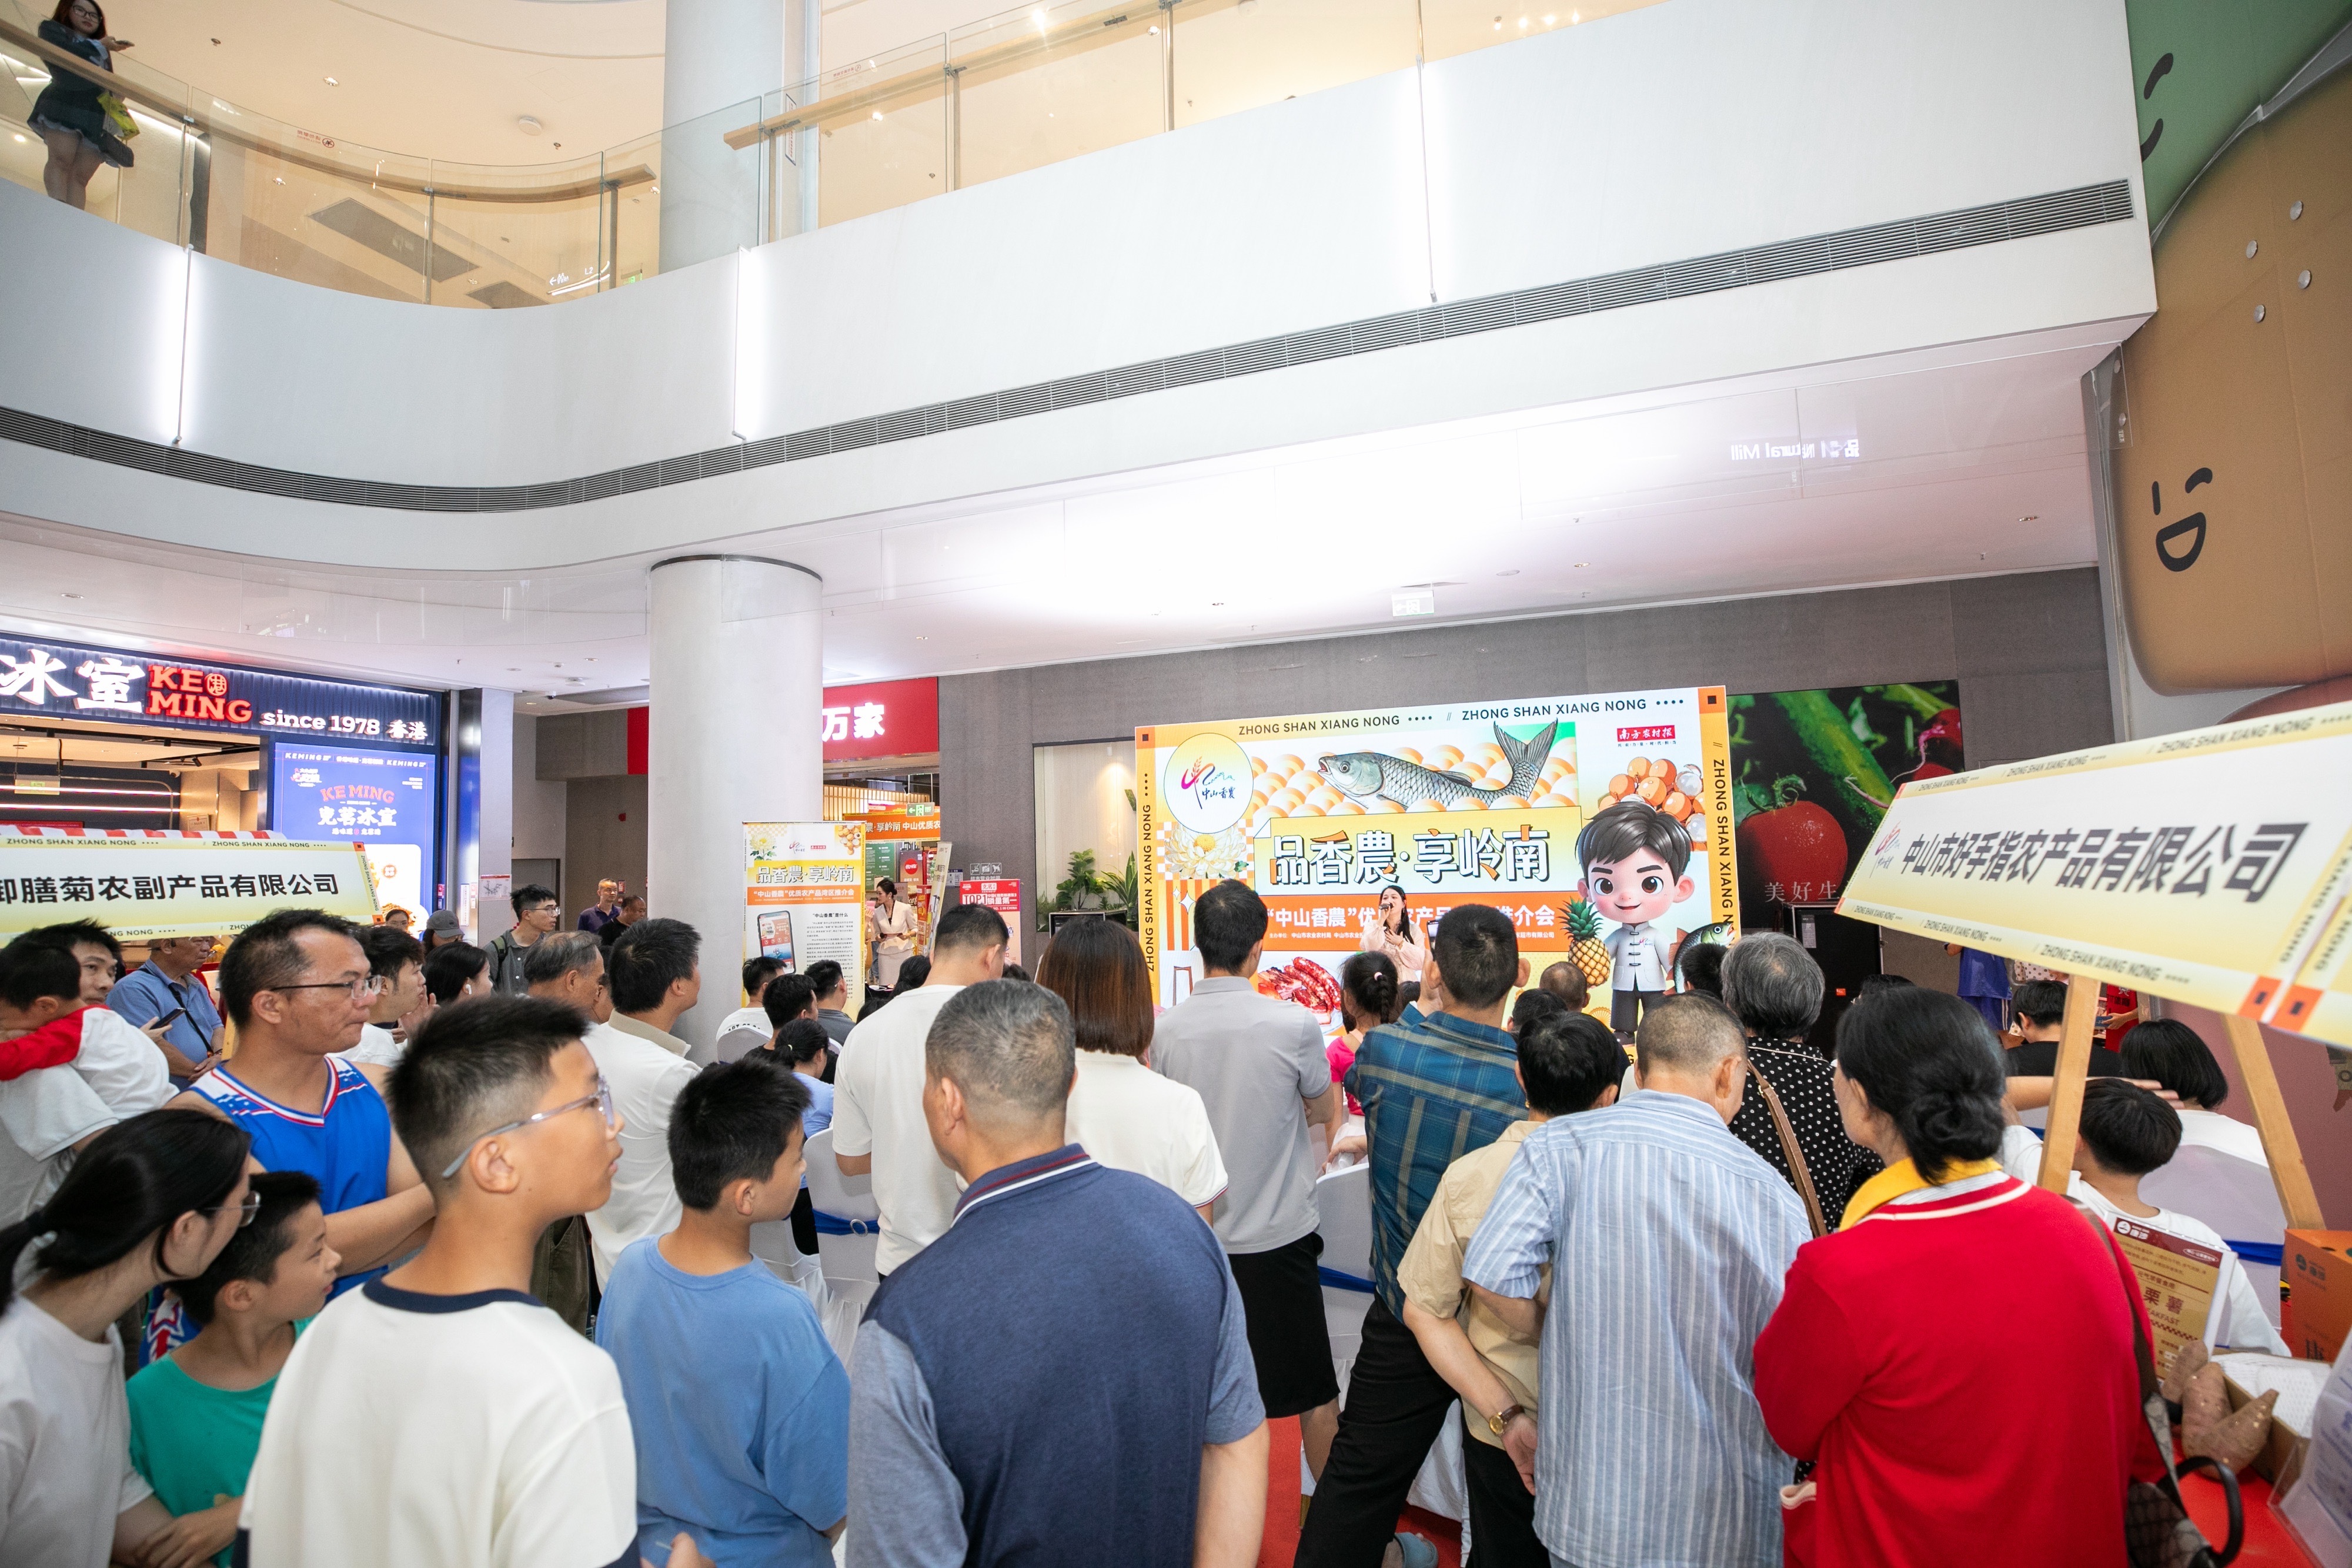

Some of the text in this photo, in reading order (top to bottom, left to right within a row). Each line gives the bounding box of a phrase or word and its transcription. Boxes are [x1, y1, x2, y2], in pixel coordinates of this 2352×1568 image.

[584, 266, 594, 275] L2
[0, 648, 145, 713] 冰室
[148, 664, 204, 693] KE
[146, 691, 253, 723] MING
[821, 702, 886, 742] 万家
[1462, 699, 1646, 721] ZHONG SHAN XIANG NONG
[260, 710, 427, 740] since 1978 香港
[1238, 715, 1400, 735] ZHONG SHAN XIANG NONG
[1619, 727, 1673, 740] 南方农村报
[285, 753, 323, 761] KEMING
[320, 785, 395, 803] KE MING
[1713, 760, 1727, 811] ZHONG
[1142, 804, 1151, 841] NONG
[1717, 815, 1730, 856] SHAN
[1143, 845, 1152, 884] XIANG
[1269, 824, 1550, 885] 品香農·享岭南
[1901, 823, 2309, 902] 中山市好手指农产品有限公司
[756, 864, 854, 884] 品香農·享岭南
[1720, 862, 1733, 908] XIANG
[964, 894, 987, 905] TOP1
[1765, 881, 1849, 902] 美好生
[1145, 928, 1154, 972] ZHONG
